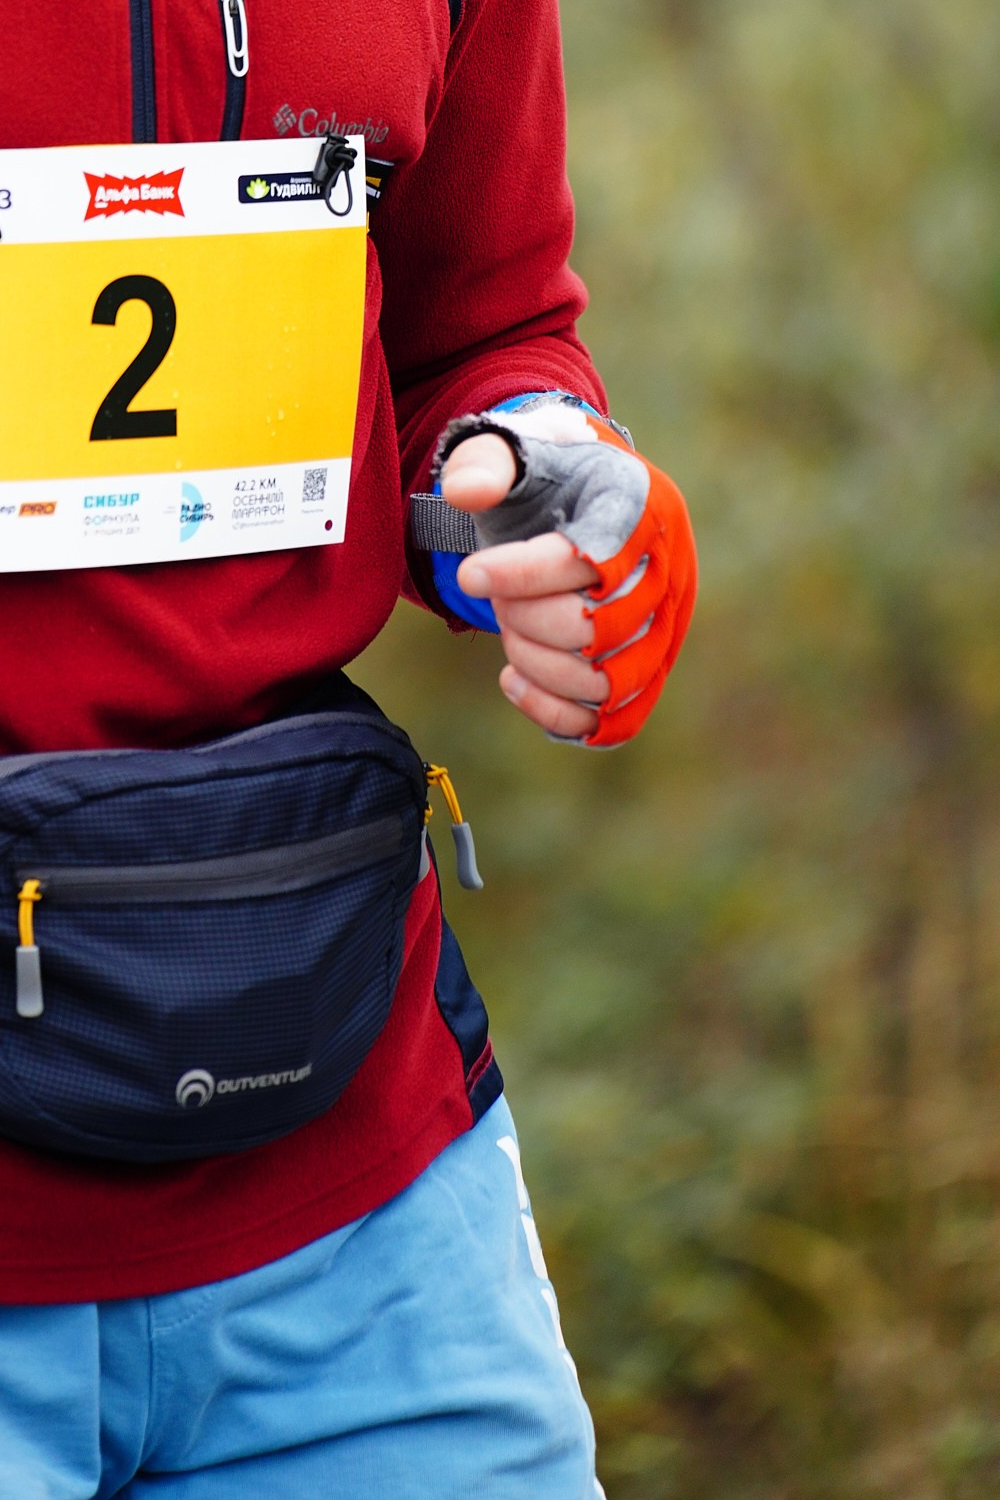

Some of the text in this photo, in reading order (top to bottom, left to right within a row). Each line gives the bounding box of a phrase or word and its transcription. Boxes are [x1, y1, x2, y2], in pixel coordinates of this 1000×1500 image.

[89, 274, 178, 442] 2
[20, 502, 56, 516] PRO
[83, 493, 140, 509] СИБУР
